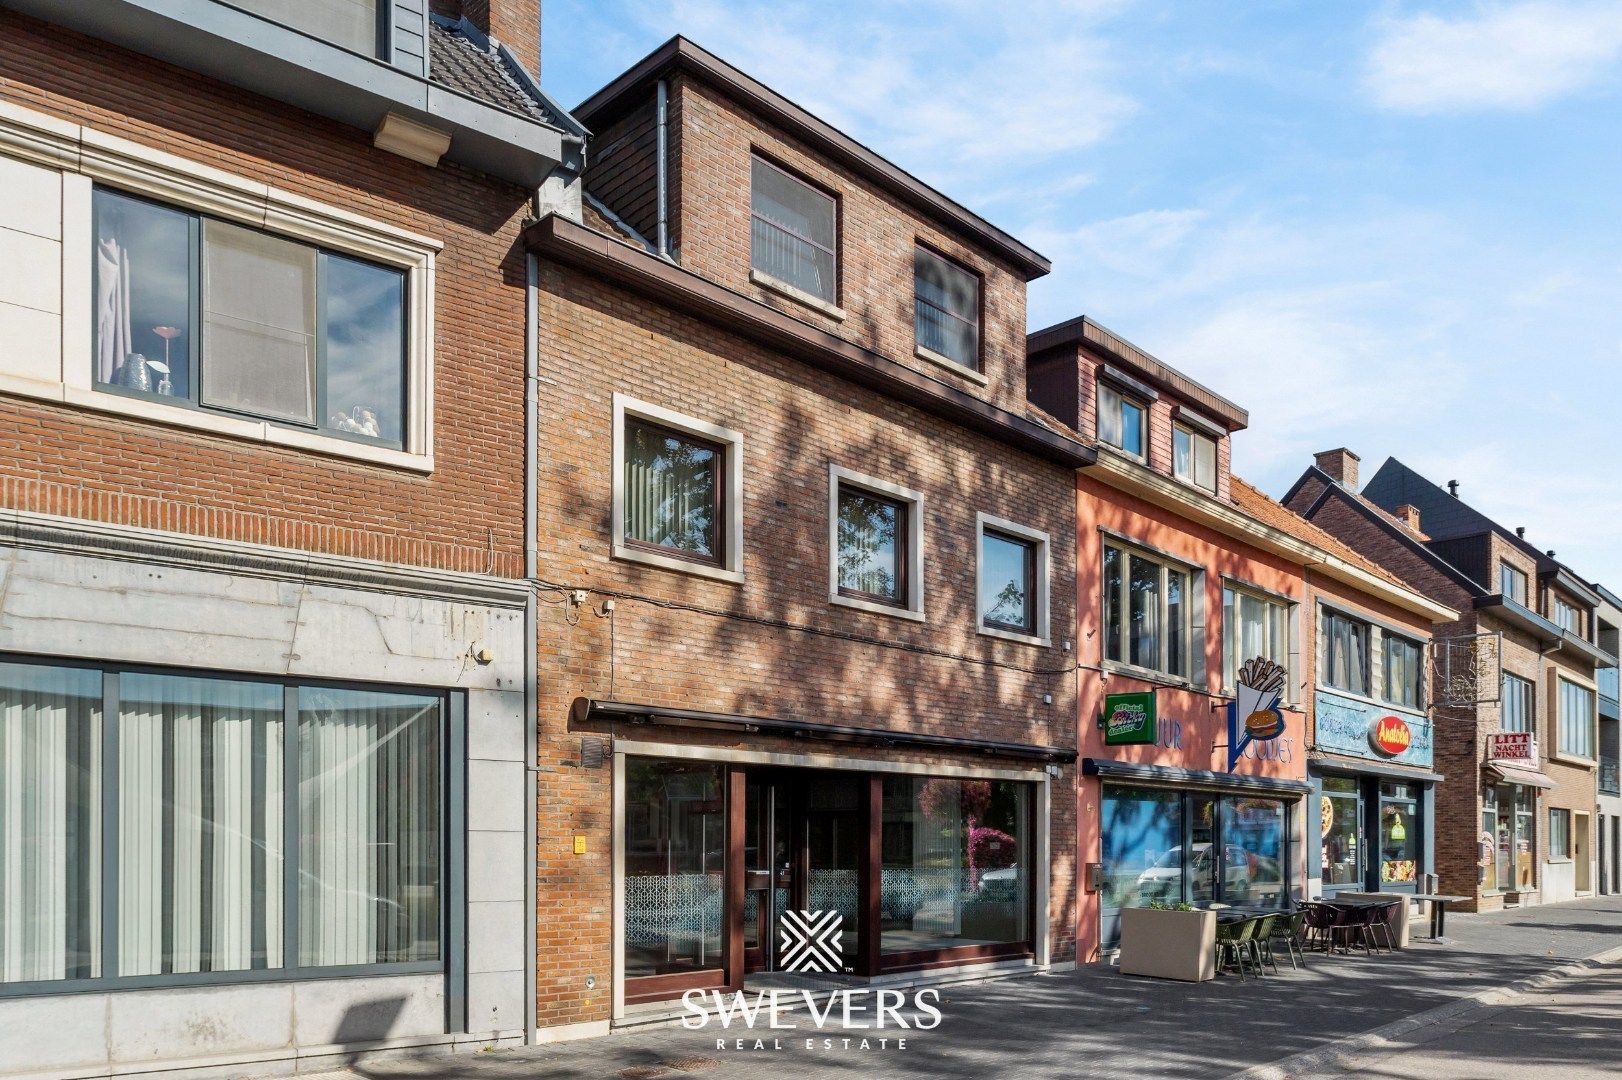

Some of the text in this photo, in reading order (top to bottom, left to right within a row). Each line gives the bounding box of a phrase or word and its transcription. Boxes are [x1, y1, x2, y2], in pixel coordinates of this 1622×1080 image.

[1494, 733, 1530, 744] LITT
[1495, 744, 1527, 752] NACHT
[1493, 751, 1530, 759] WINKEL
